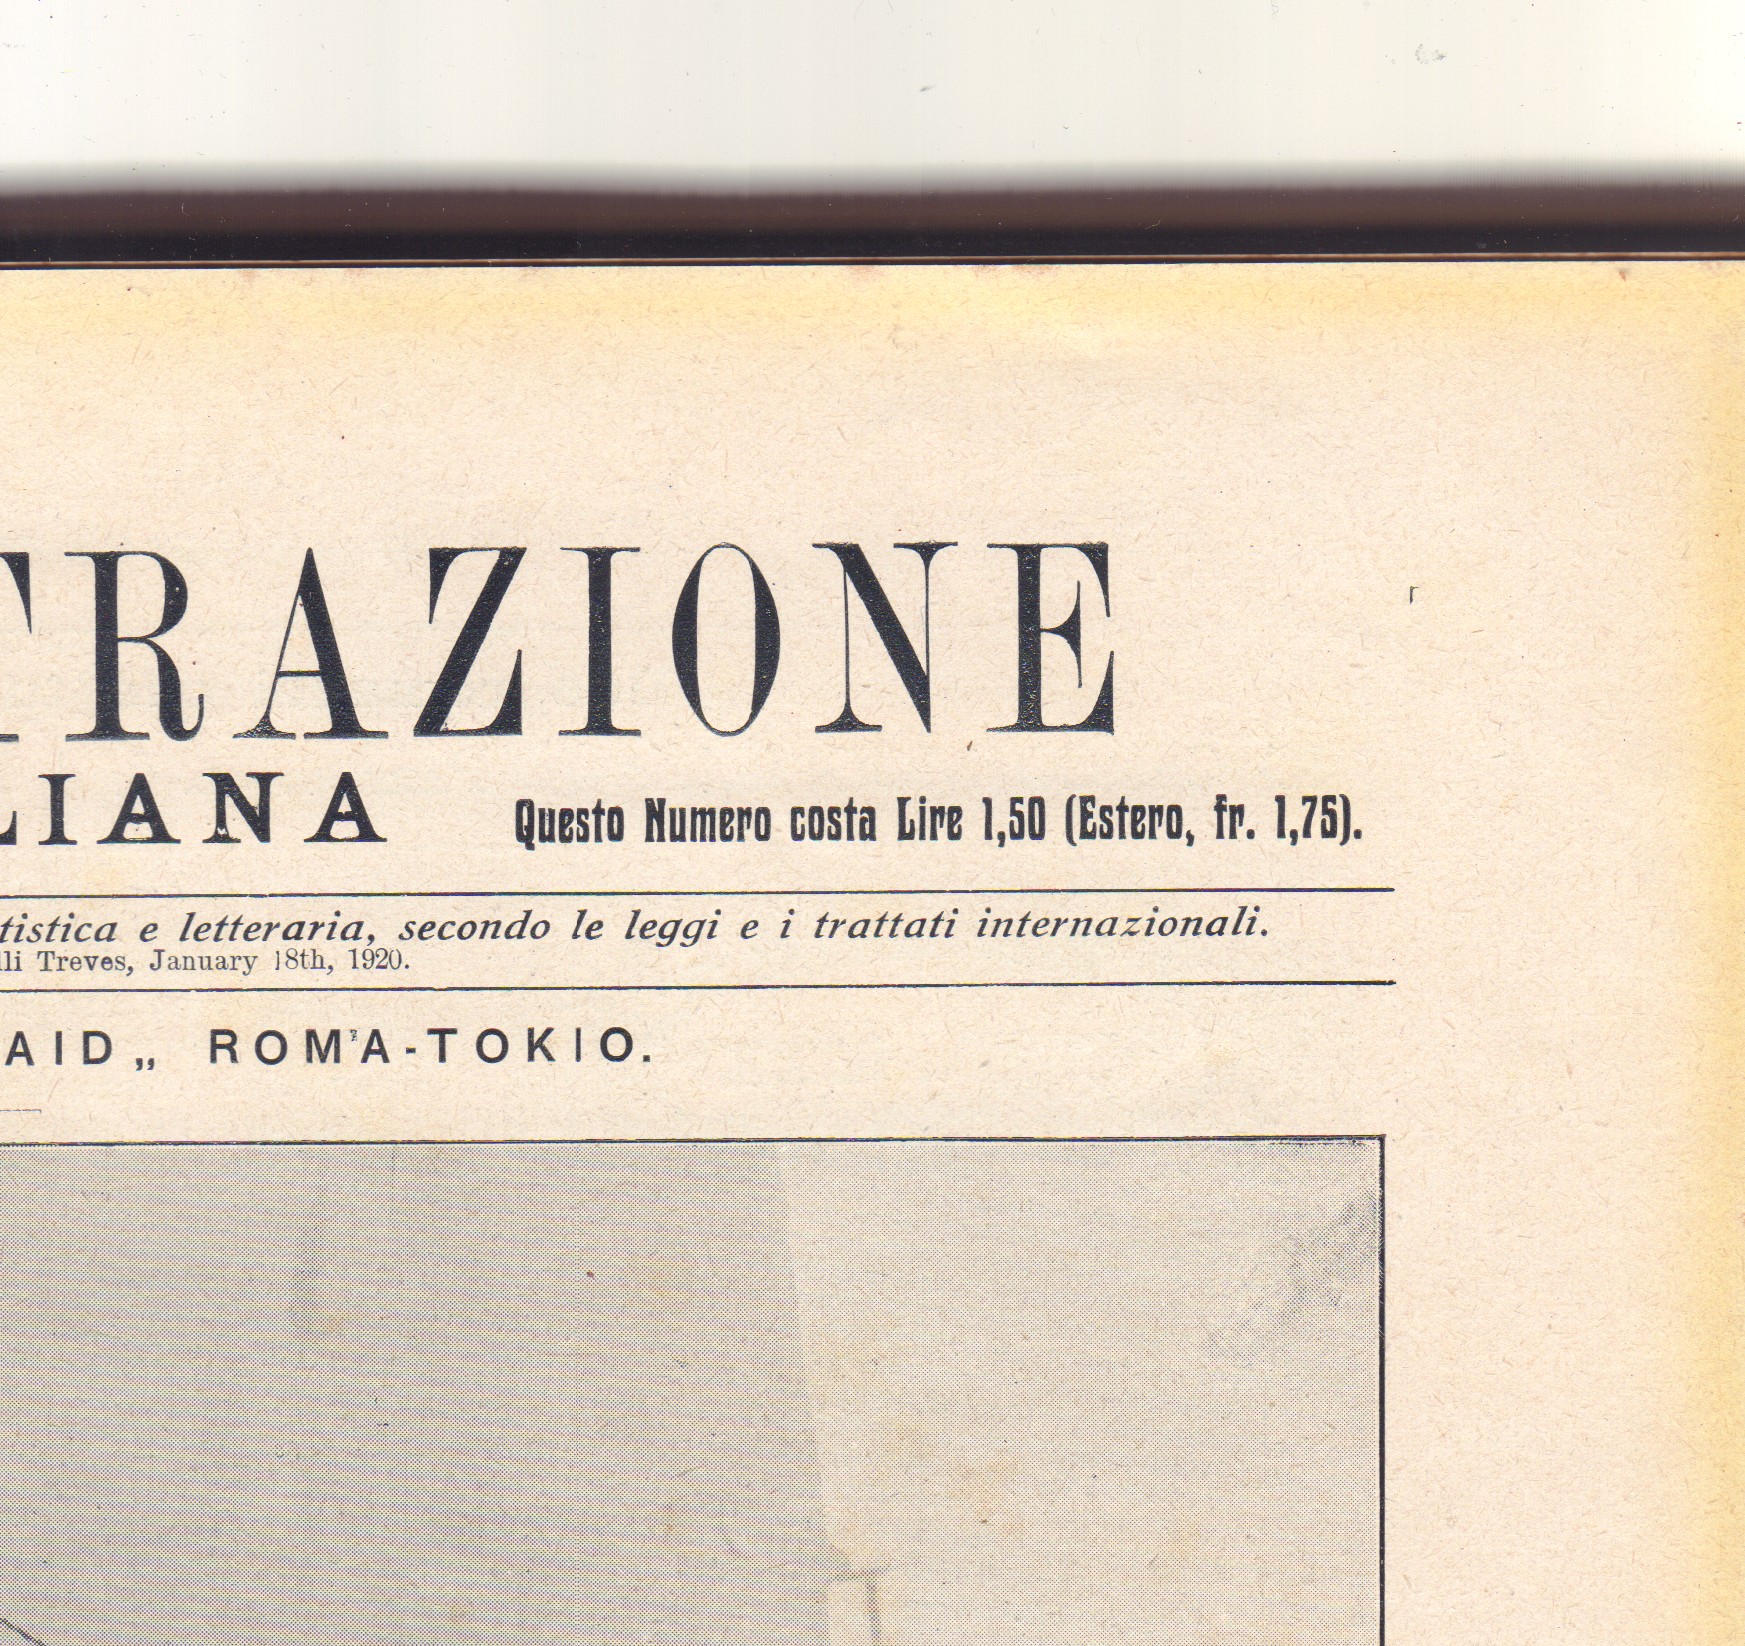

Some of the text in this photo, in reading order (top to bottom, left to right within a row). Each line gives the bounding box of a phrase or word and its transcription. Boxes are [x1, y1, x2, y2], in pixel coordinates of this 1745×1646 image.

[515, 793, 1363, 851] Questo Numero costa Lire 1,50 (Estero, fr. 1,75).
[139, 922, 159, 943] e
[179, 909, 375, 947] letteraria,
[398, 909, 551, 941] secondo
[571, 908, 604, 941] le
[624, 908, 722, 948] leggi
[740, 919, 759, 940] e
[780, 908, 795, 939] i
[814, 907, 959, 939] trattati
[976, 905, 1268, 938] internazionali.
[36, 950, 134, 977] Treves,
[149, 948, 258, 977] January
[275, 948, 334, 976] 18th,
[348, 947, 410, 971] 1920.
[209, 1026, 651, 1066] ROMA-TOKIO.
